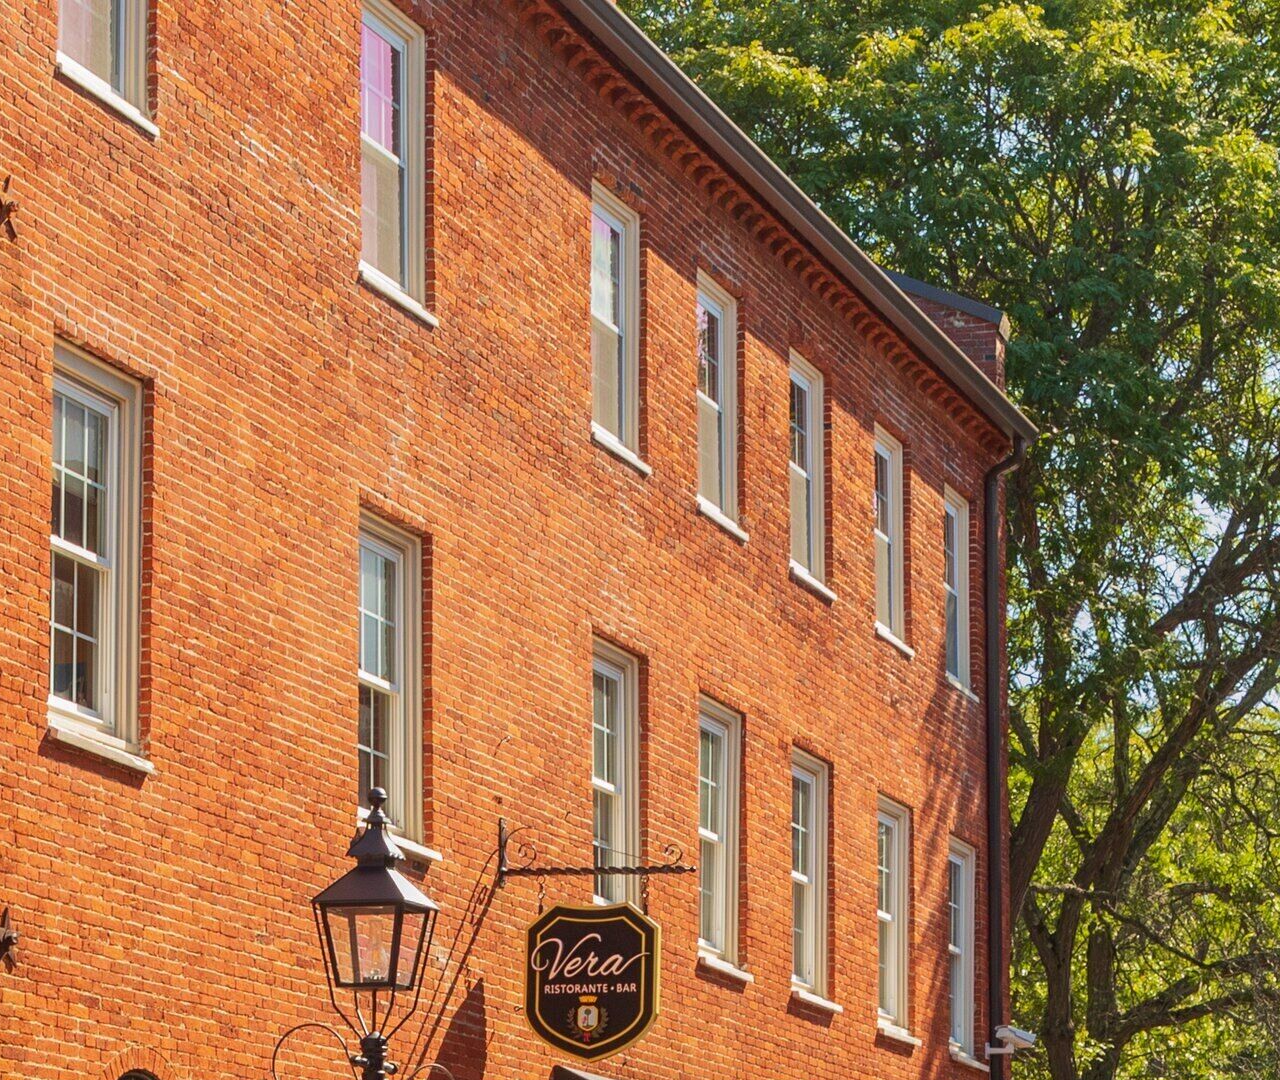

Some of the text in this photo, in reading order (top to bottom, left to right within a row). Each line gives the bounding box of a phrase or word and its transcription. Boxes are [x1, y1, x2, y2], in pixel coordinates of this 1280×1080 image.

[531, 933, 650, 980] Vera
[544, 983, 637, 994] RISTORANTE BAR
